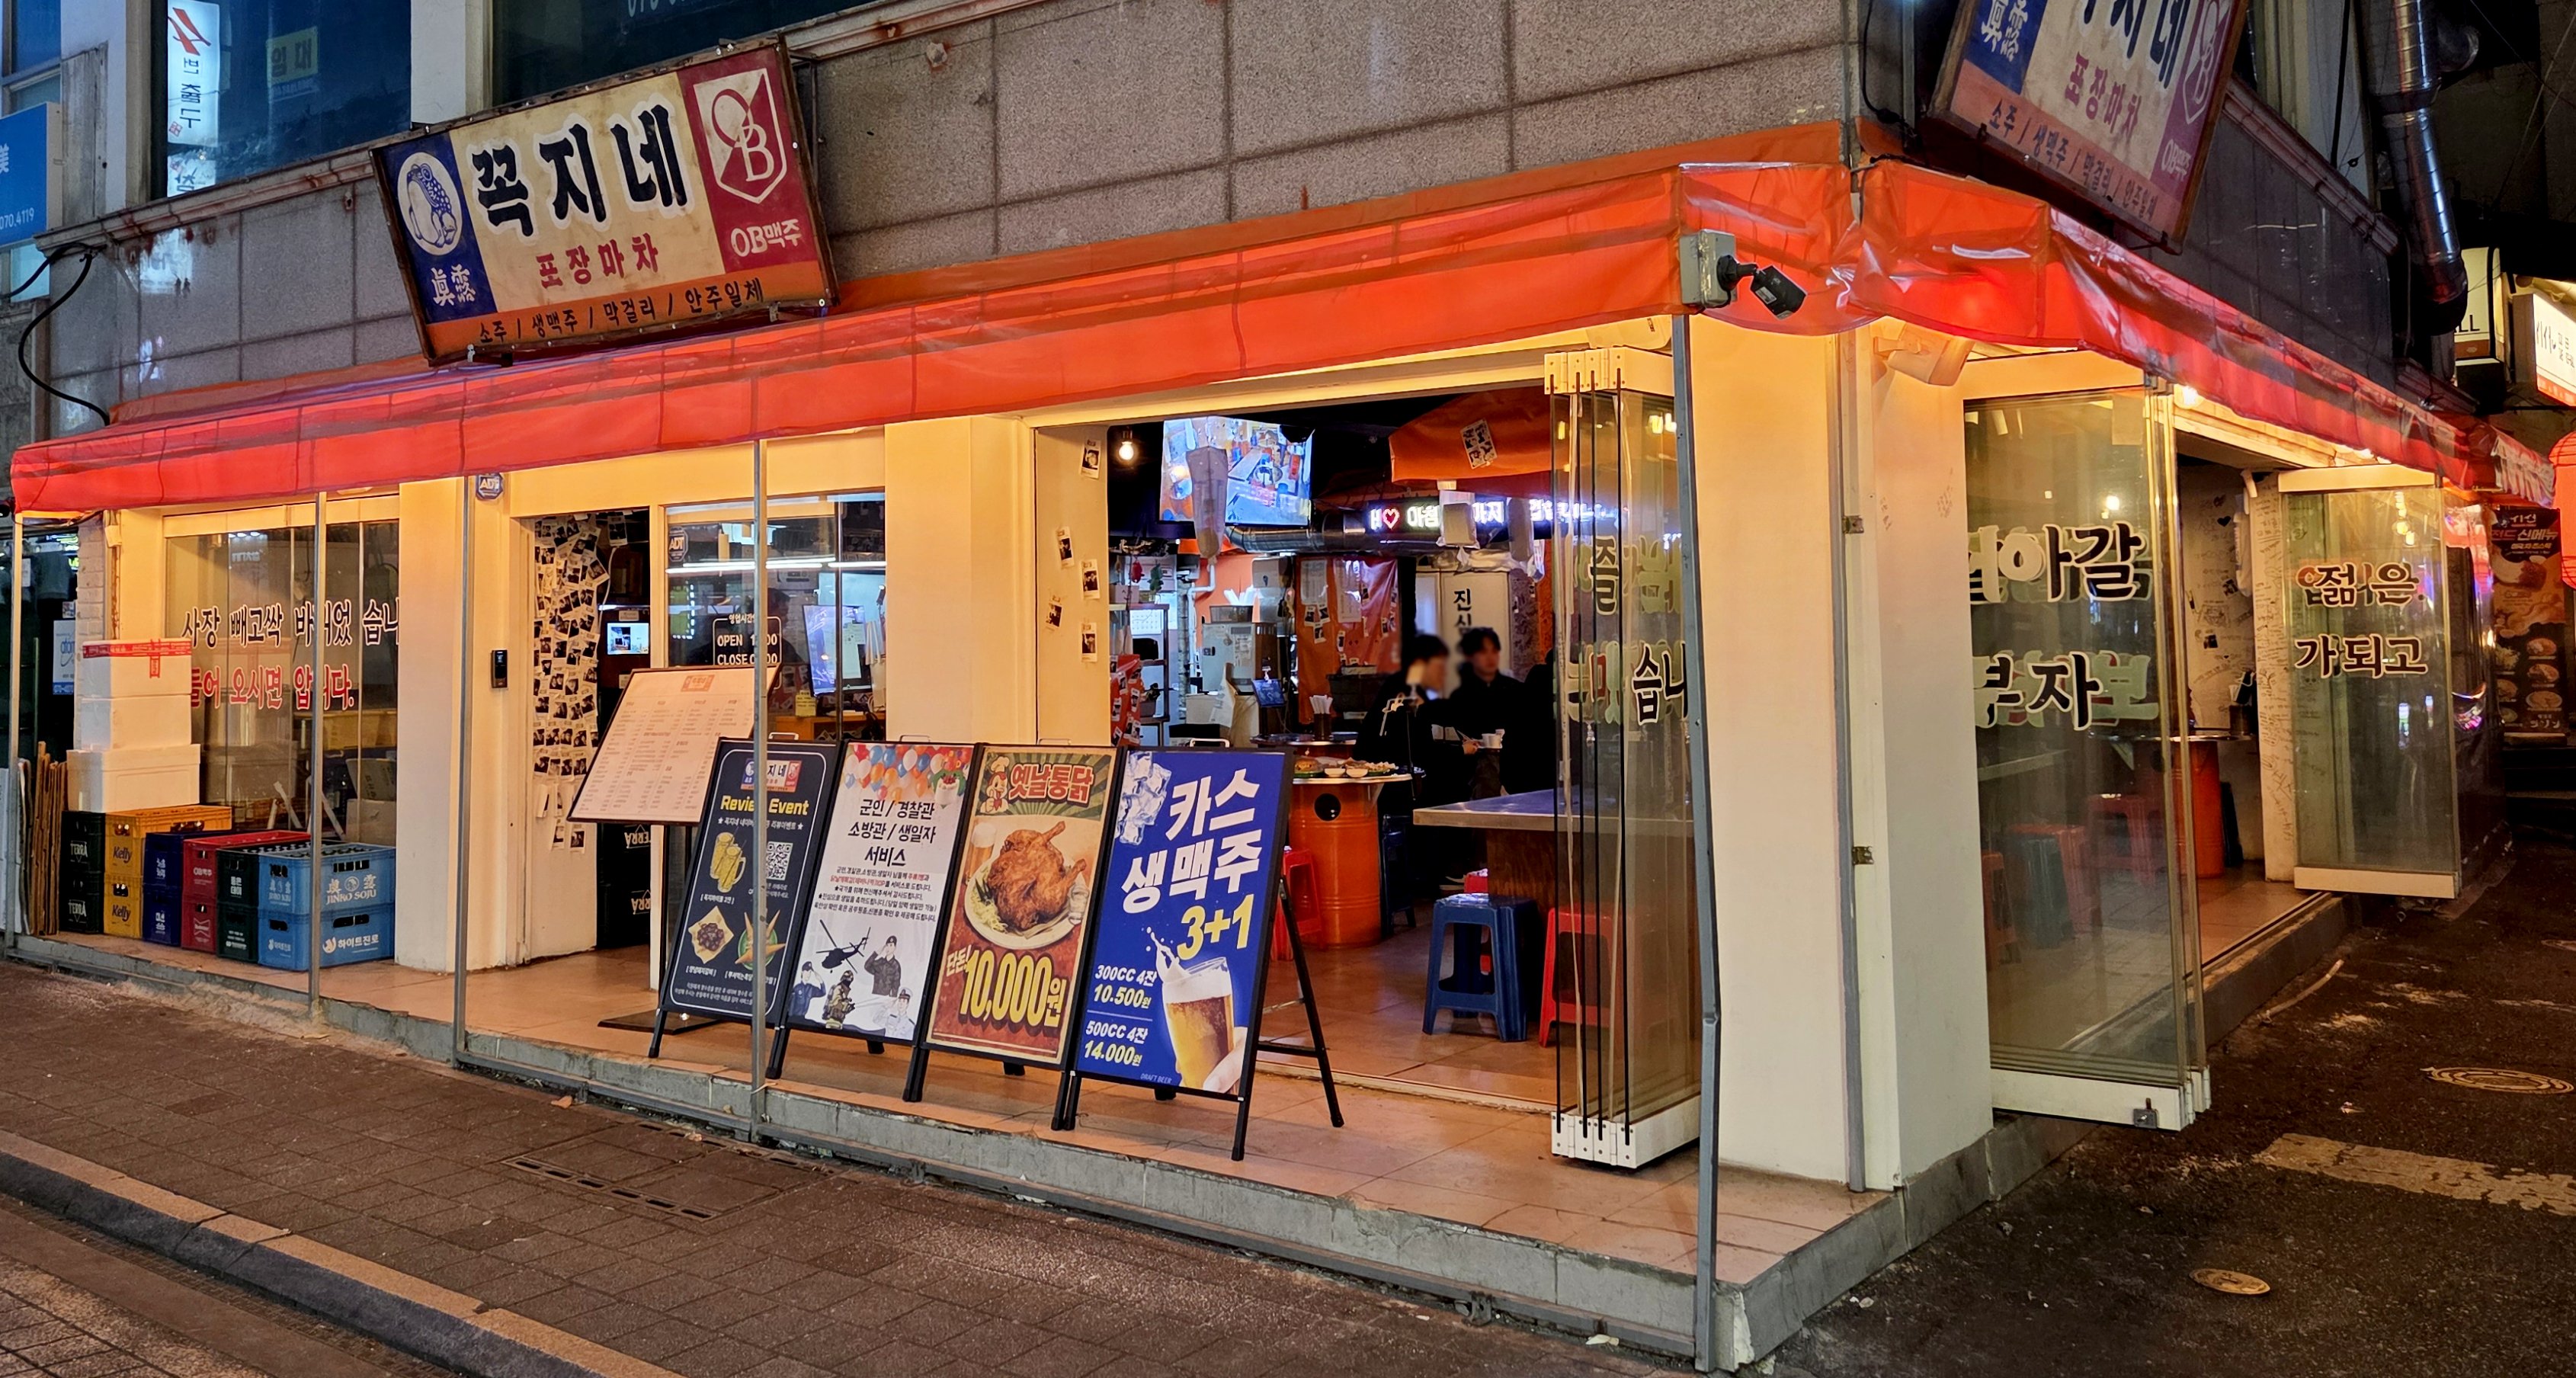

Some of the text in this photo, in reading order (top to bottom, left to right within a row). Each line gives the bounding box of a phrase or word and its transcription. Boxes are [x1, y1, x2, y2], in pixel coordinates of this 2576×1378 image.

[2064, 51, 2142, 146] 포장마차
[1988, 97, 2015, 136] 소주
[472, 104, 687, 238] 꼭지네
[730, 218, 802, 258] OB맥주
[536, 232, 658, 290] 포장마차
[479, 320, 507, 343] 소주
[531, 308, 578, 338] 생맥주
[603, 294, 656, 327] 막걸리
[685, 277, 763, 316] 안주일체
[669, 536, 685, 550] ADT
[181, 606, 220, 649] 사장
[230, 603, 284, 648] 빼고싹
[729, 613, 755, 624] 영업시간
[717, 634, 743, 646] OPEN
[717, 654, 748, 665] CLOSE
[230, 665, 283, 710] 오시면
[767, 764, 787, 777] 지네
[1009, 763, 1094, 804] 옛날통닭
[720, 795, 809, 816] Revie Event
[860, 799, 885, 816] 군인
[897, 801, 935, 820] 경찰관
[1165, 768, 1260, 840] 카스
[624, 831, 651, 848] ERRA
[847, 822, 886, 840] 소방관
[899, 825, 937, 844] 생일자
[114, 846, 133, 863] Kelly
[864, 846, 906, 867] 서비스
[1121, 829, 1262, 914] 생맥주
[354, 889, 376, 900] SOJU
[112, 905, 131, 921] Kelly
[1177, 894, 1254, 961] 3+1
[338, 934, 380, 949] 하이트진로
[1095, 965, 1158, 987] 300CC 4잔
[960, 950, 1065, 1027] 10,000원
[1094, 984, 1152, 1008] 10.500원
[1085, 1021, 1148, 1044] 500CC 4잔
[1085, 1040, 1142, 1066] 14.000원
[1140, 1073, 1172, 1084] DRAFT BEER
